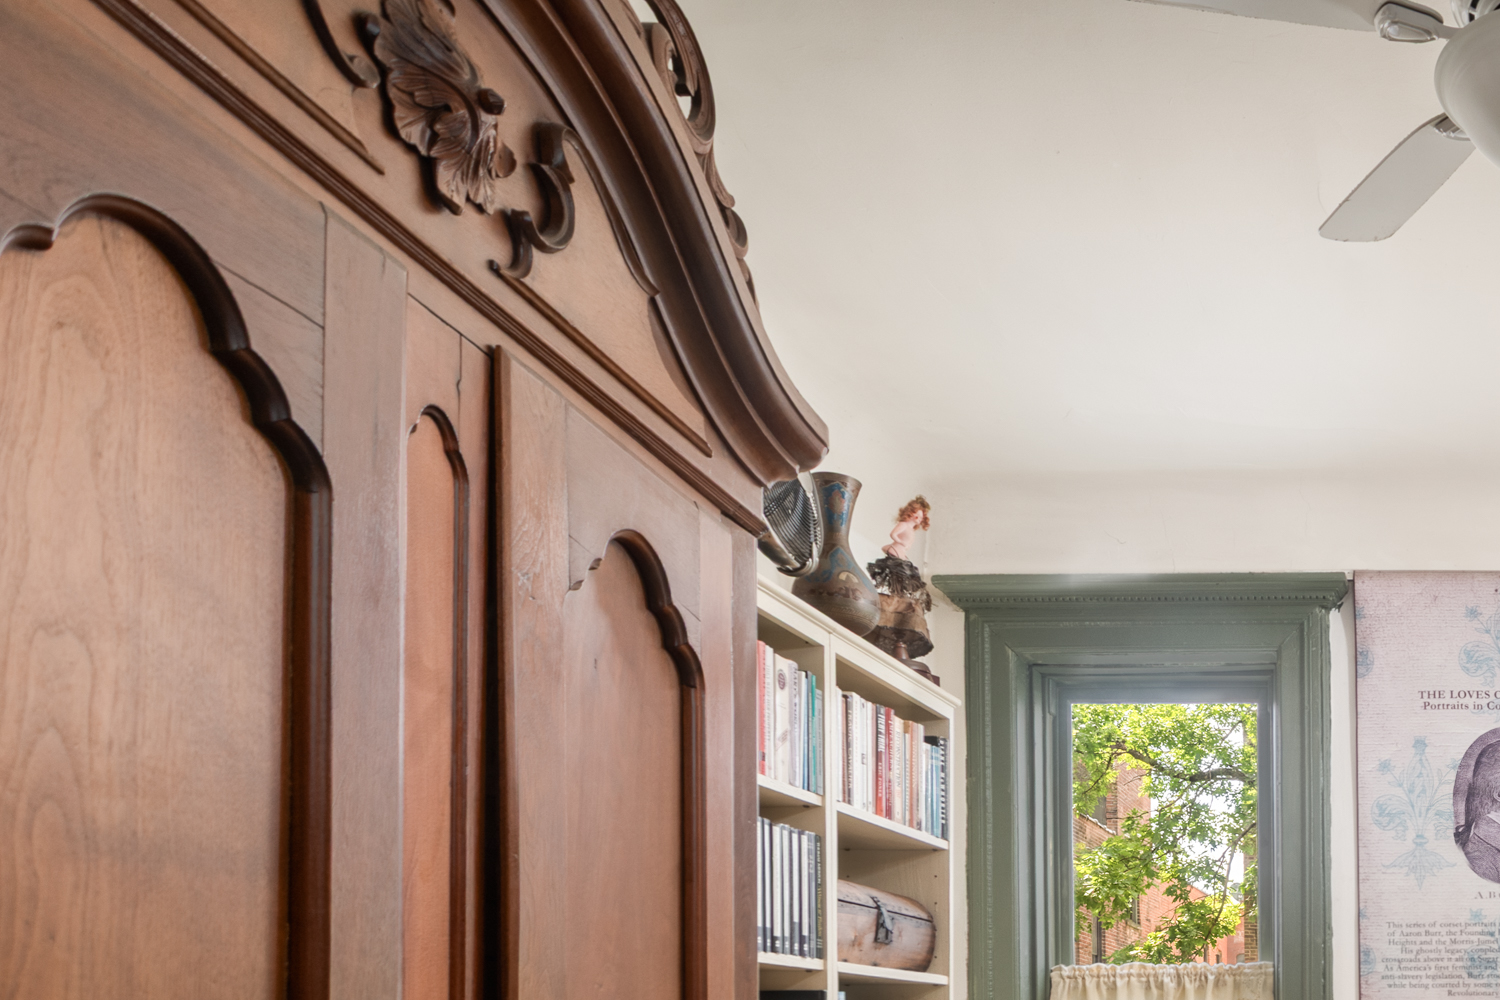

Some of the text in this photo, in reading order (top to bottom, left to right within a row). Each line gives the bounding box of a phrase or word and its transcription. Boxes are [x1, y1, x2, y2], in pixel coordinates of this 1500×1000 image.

[1418, 690, 1446, 700] THE
[1449, 690, 1491, 700] LOVES
[1423, 701, 1470, 710] Portraits
[1473, 701, 1483, 710] in
[1440, 920, 1462, 928] corset
[1464, 920, 1496, 930] portraits
[1387, 929, 1395, 937] of
[1399, 929, 1422, 937] Aaron
[1424, 929, 1444, 938] Burr,
[1388, 938, 1417, 948] Heights
